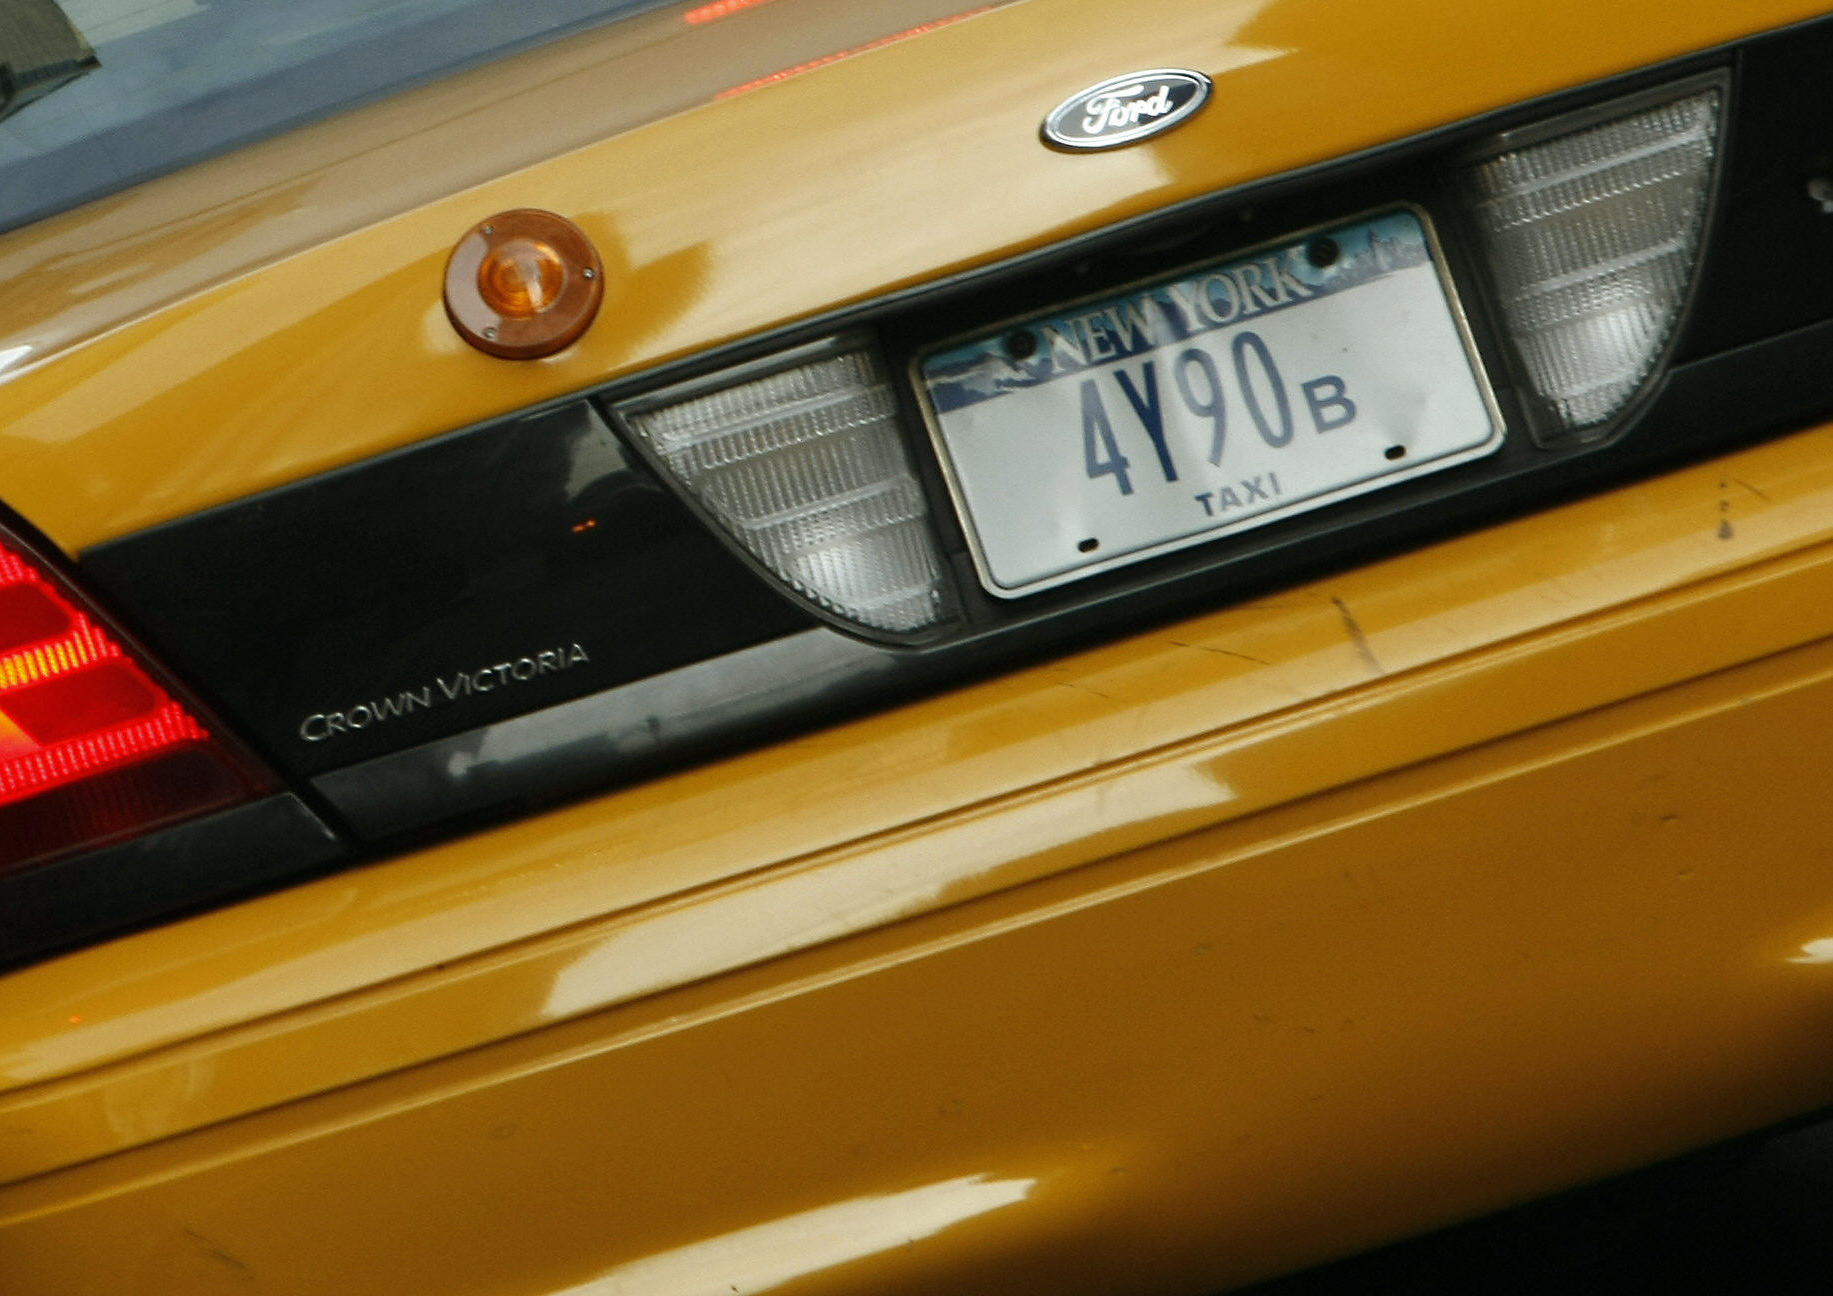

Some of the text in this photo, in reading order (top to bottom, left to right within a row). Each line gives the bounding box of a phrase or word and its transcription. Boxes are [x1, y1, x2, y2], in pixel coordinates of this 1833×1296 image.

[1081, 84, 1173, 135] Ford
[1043, 258, 1312, 376] NEW YORK
[1194, 471, 1284, 517] TAXI
[299, 643, 590, 742] CROWN VICTORIA
